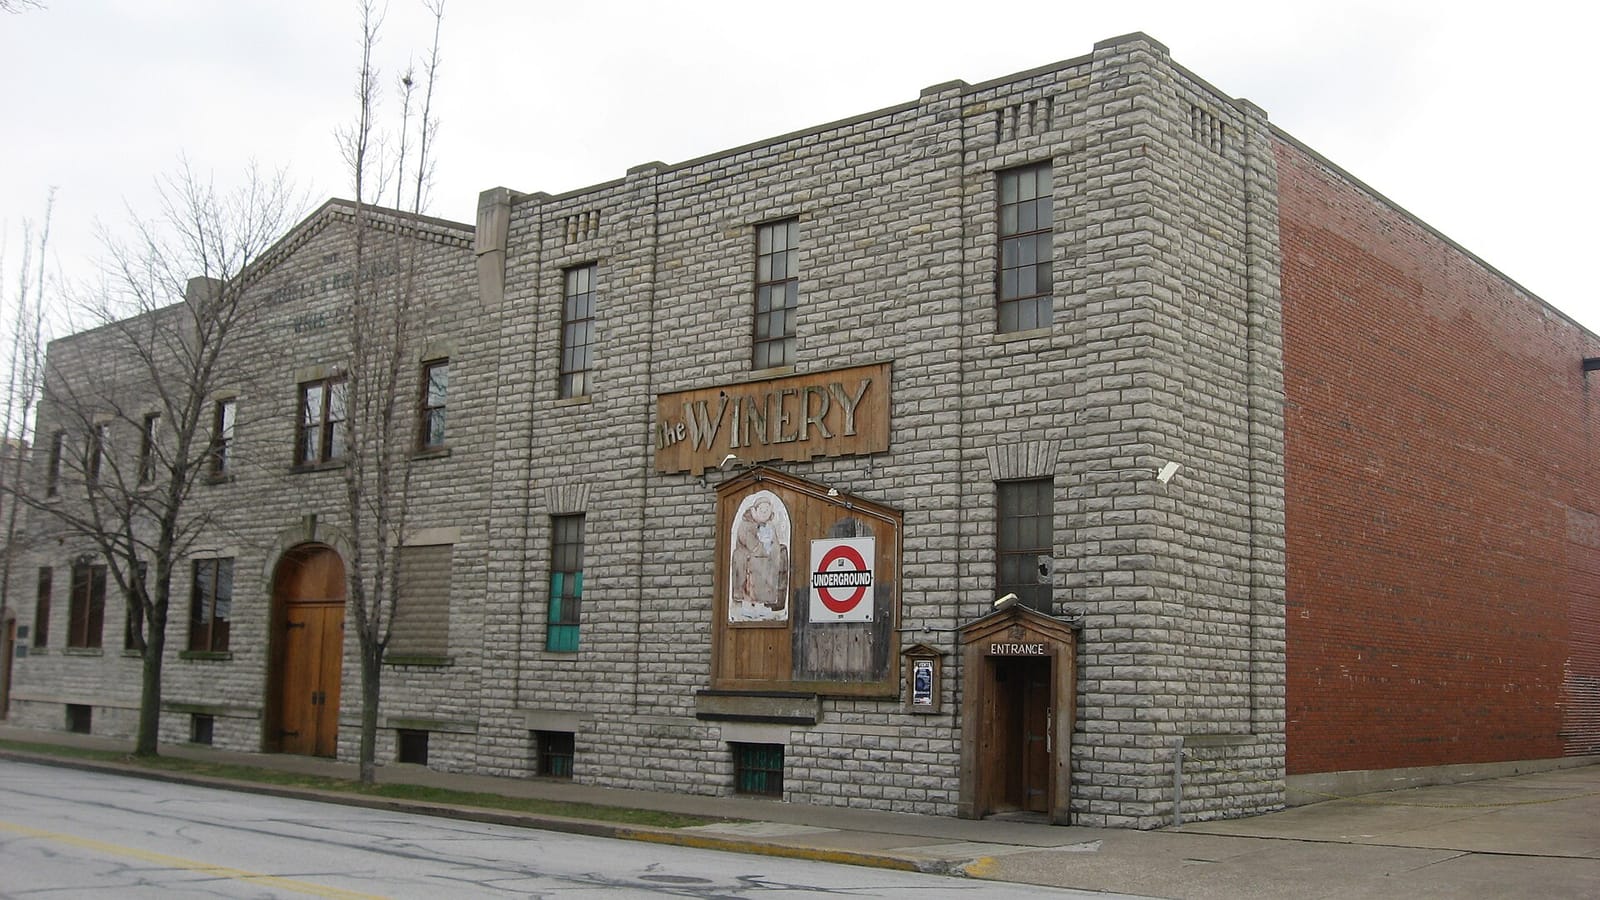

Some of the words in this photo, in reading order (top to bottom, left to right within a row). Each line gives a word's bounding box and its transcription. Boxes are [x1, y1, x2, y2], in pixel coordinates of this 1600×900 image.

[683, 378, 872, 452] WINERY
[813, 571, 871, 587] UNDERGROUND
[991, 643, 1044, 655] ENTRANCE
